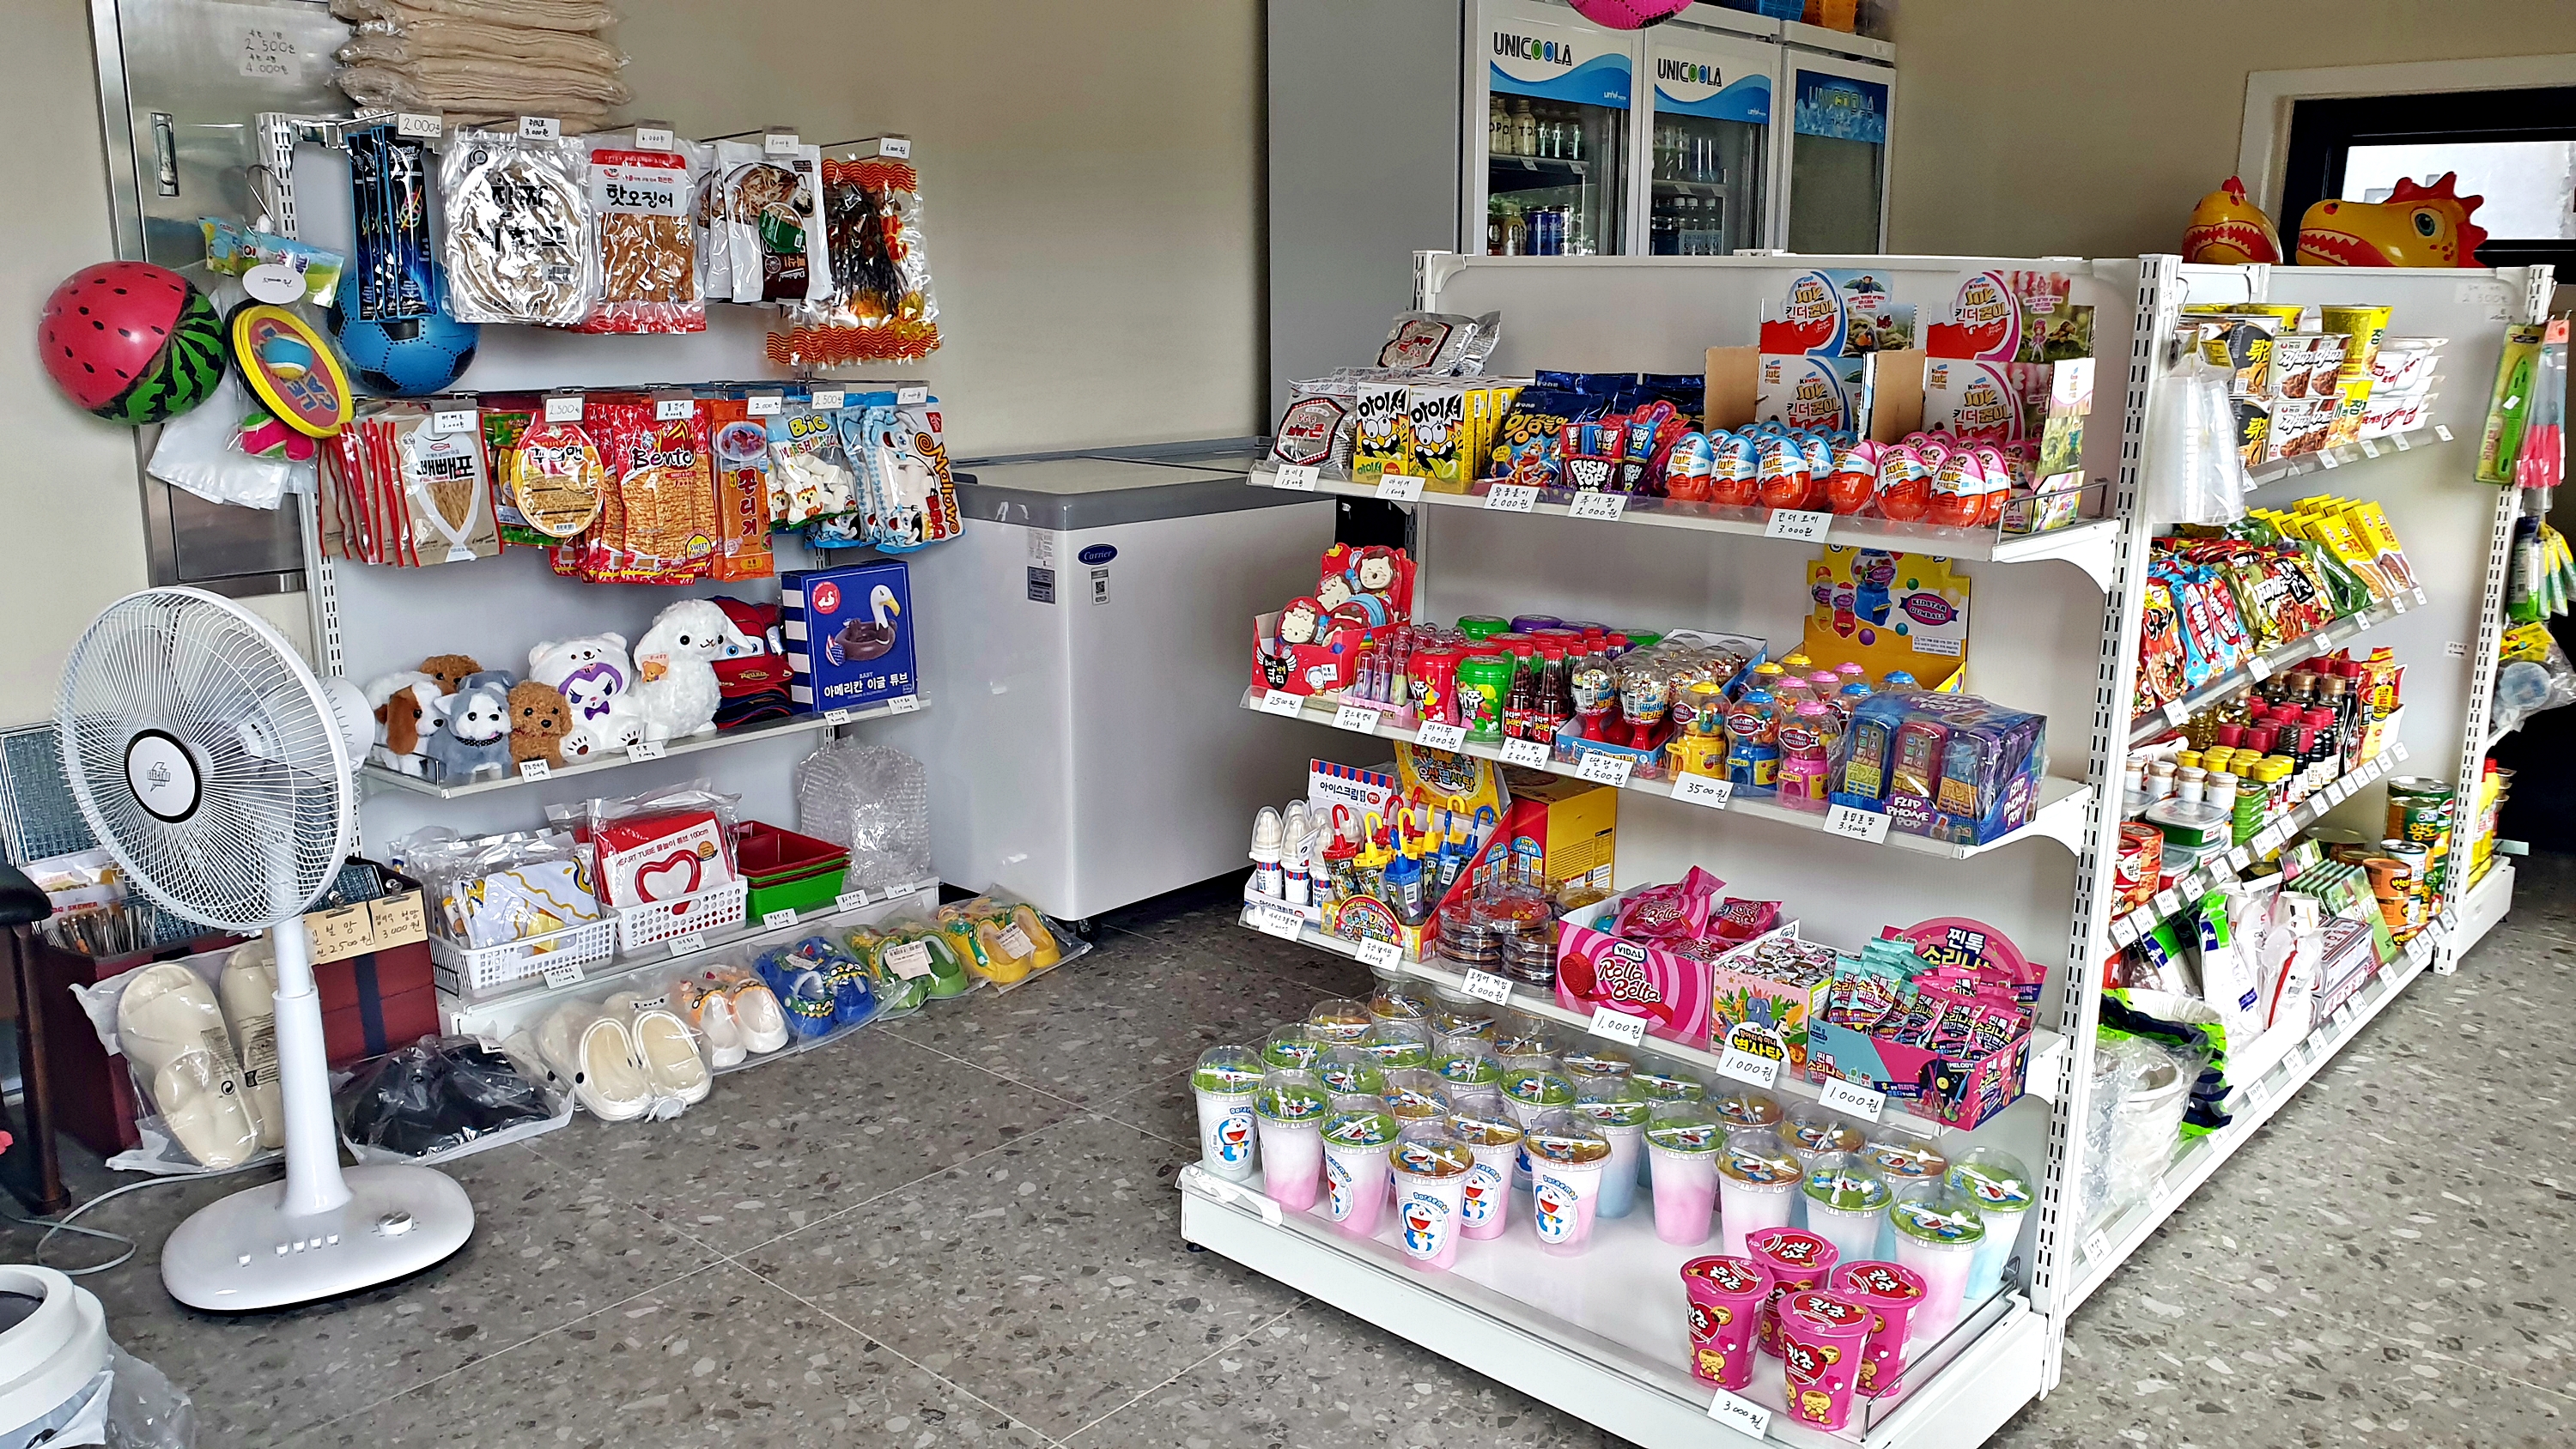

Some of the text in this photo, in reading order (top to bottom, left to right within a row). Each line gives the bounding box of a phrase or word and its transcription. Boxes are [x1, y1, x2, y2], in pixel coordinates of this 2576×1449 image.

[1493, 31, 1572, 66] UNICOOLA
[1657, 58, 1722, 88] UNICOOLA
[605, 184, 674, 209] 핫오징어
[1794, 287, 1824, 304] JOY
[1965, 288, 1997, 306] JOY
[1358, 388, 1407, 419] 아이셔
[1795, 383, 1828, 401] JOY
[1964, 389, 1998, 408] JOY
[1411, 393, 1463, 424] 아이셔
[633, 446, 693, 470] Bento
[1570, 458, 1609, 476] PUSH
[1577, 474, 1606, 487] POP
[1083, 549, 1113, 561] Carrier
[1910, 607, 1947, 621] GUMBALL
[1911, 598, 1947, 613] KIDSTAR
[823, 671, 909, 699] 아메리칸 이글 튜브
[1419, 767, 1476, 793] 우산별사탕
[1320, 781, 1359, 803] 아이스크림
[1893, 797, 1923, 809] FLIP
[2003, 788, 2028, 817] PHONE
[1886, 805, 1930, 822] PHONE
[1895, 816, 1923, 829] POP
[2007, 806, 2023, 828] POP
[638, 847, 656, 858] TUBE
[689, 828, 709, 840] 100cm
[1617, 945, 1643, 959] VIDAL
[1947, 928, 1985, 955] 찐톡
[1470, 972, 1490, 984] 오징어
[1599, 959, 1645, 982] Rolla
[1613, 978, 1661, 1003] Belta
[1597, 1015, 1641, 1040] 1.000원
[1726, 1057, 1773, 1082] 1.000원
[1830, 1086, 1880, 1113] 1.000원
[1542, 1174, 1578, 1201] Doraemon
[1413, 1191, 1450, 1215] Doraemon
[1807, 1297, 1846, 1319] 칸쵸
[1786, 1343, 1815, 1371] 칸쵸
